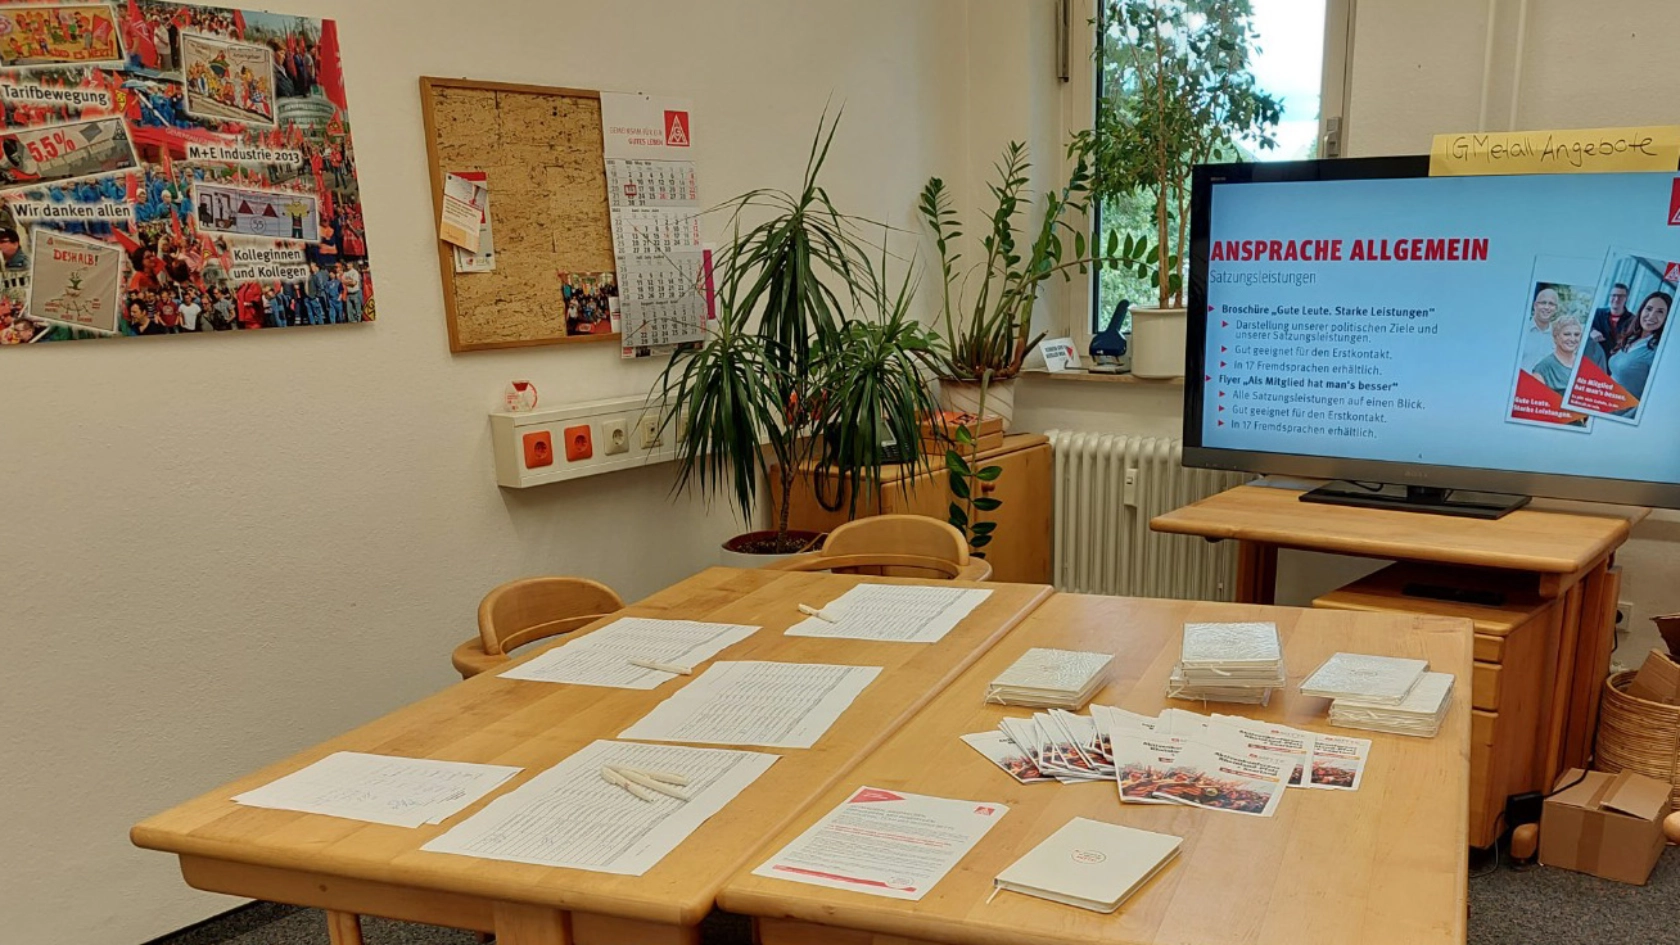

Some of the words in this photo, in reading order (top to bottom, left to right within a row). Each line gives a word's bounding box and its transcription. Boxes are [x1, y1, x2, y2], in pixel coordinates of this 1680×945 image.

[2, 84, 107, 106] Tarifbewegung
[26, 129, 77, 162] 5,5%
[1540, 132, 1657, 167] Angebote
[189, 147, 218, 159] M+E
[221, 147, 272, 160] Industrie
[275, 151, 300, 163] 2013
[14, 203, 39, 217] Wir
[42, 203, 94, 217] danken
[98, 203, 131, 217] allen
[53, 248, 98, 266] DESHALB!
[234, 248, 301, 263] Kolleginnen
[1210, 239, 1343, 261] ANSPRACHE
[1349, 238, 1489, 261] ALLGEMEIN
[234, 267, 255, 279] und
[258, 267, 307, 279] Kollegen
[1210, 270, 1316, 286] Satzungsleistungen
[1221, 304, 1270, 315] Broschüre
[1302, 306, 1332, 316] Leute.
[1335, 306, 1368, 317] Starke
[1236, 320, 1289, 332] Darstellung
[1291, 322, 1328, 331] unserer
[1331, 321, 1387, 333] politischen
[1389, 323, 1415, 333] Ziele
[1417, 324, 1438, 334] und
[1235, 332, 1271, 340] unserer
[1272, 331, 1372, 344] Satzungsleistungen.
[1234, 345, 1251, 354] Gut
[1253, 347, 1293, 357] geeignet
[1296, 346, 1309, 356] für
[1311, 347, 1329, 357] den
[1332, 348, 1393, 360] Erstkontakt.
[1234, 361, 1243, 370] In
[1246, 361, 1255, 370] 17
[1257, 361, 1329, 374] Fremdsprachen
[1332, 364, 1383, 376] erhältlich.
[1219, 374, 1241, 385] Flyer
[1265, 376, 1305, 388] Mitglied
[1307, 379, 1323, 389] hat
[1233, 390, 1250, 400] Alle
[1252, 391, 1345, 406] Satzungsleistungen
[1347, 396, 1364, 406] auf
[1366, 397, 1394, 408] einen
[1397, 399, 1426, 410] Blick.
[1232, 404, 1248, 414] Gut
[1250, 406, 1290, 418] geeignet
[1292, 408, 1305, 418] für
[1307, 409, 1325, 419] den
[1328, 410, 1387, 423] Erstkontakt.
[1231, 420, 1240, 429] In
[1242, 420, 1251, 430] 17
[1254, 421, 1325, 434] Fremdsprachen
[1328, 426, 1378, 439] erhältlich.
